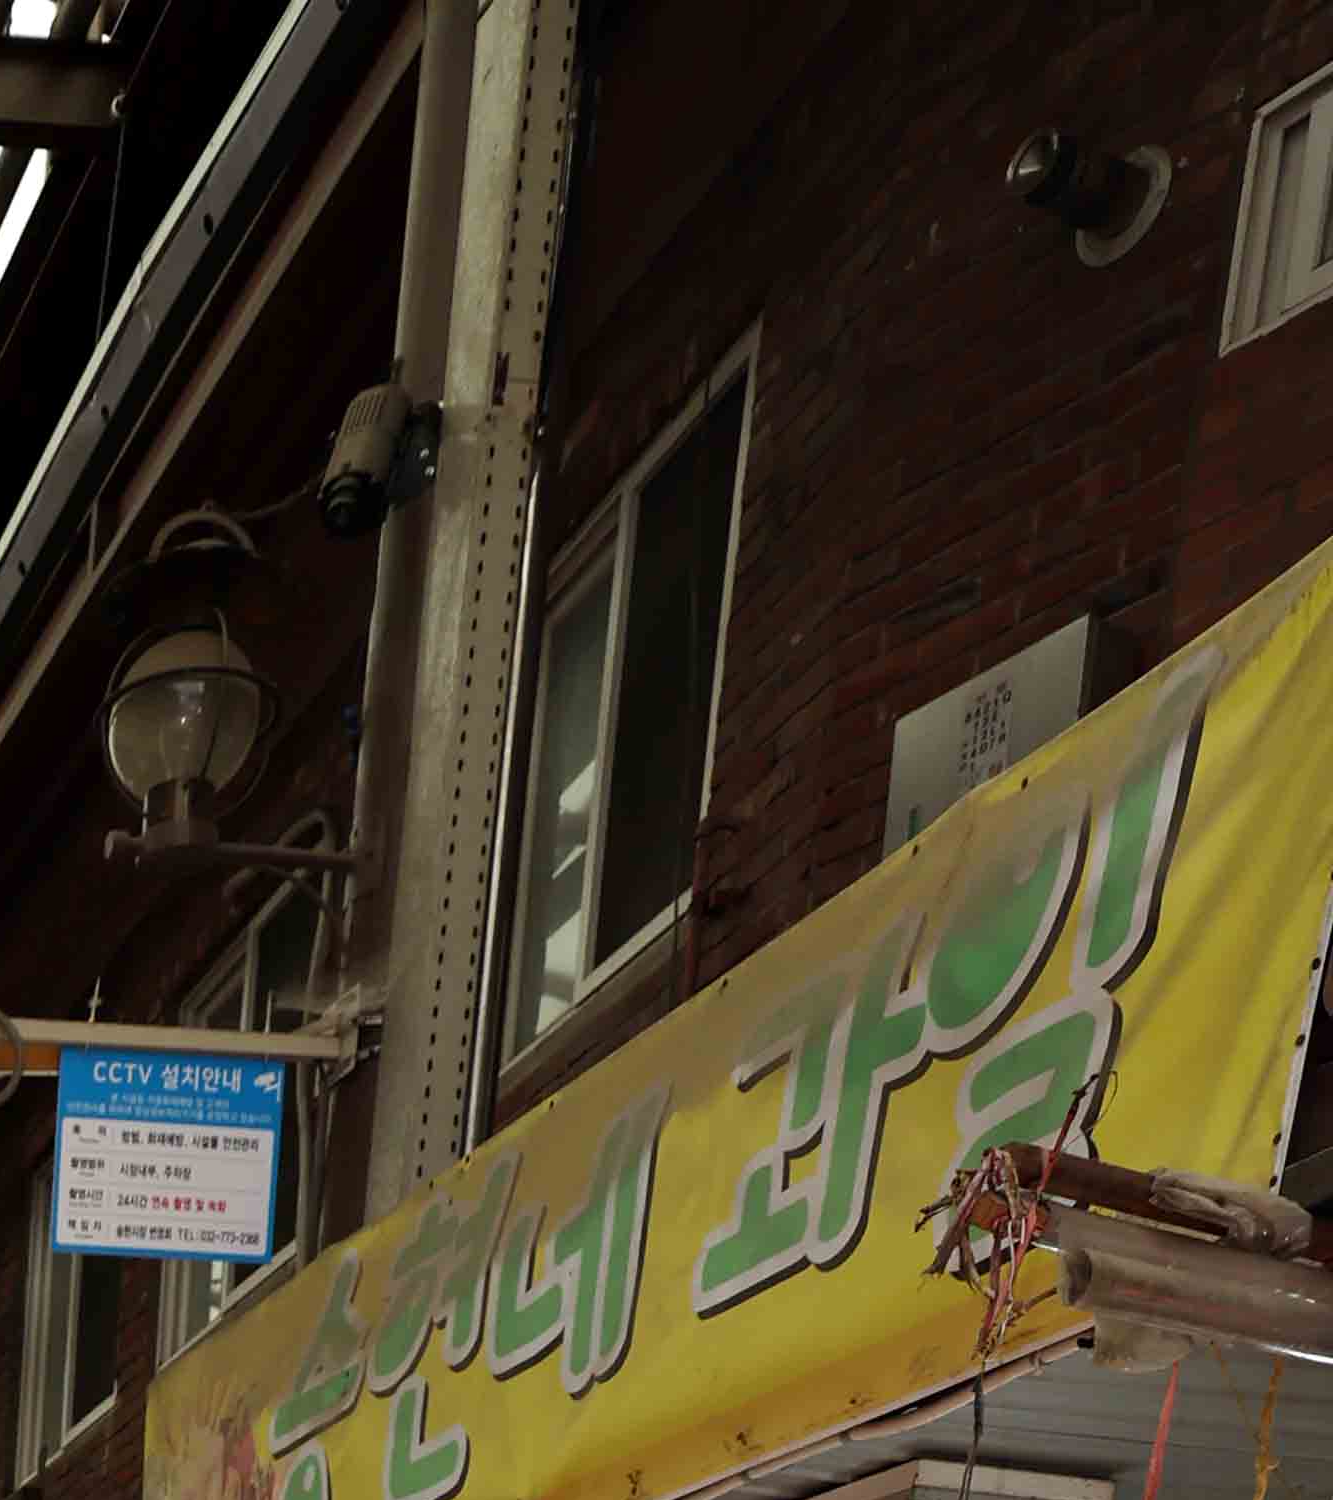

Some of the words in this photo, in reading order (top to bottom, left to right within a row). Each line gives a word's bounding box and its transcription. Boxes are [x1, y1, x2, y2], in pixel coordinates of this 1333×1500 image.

[93, 1061, 153, 1083] CCTV
[161, 1064, 242, 1093] 설치안내
[117, 1193, 148, 1208] 24시간
